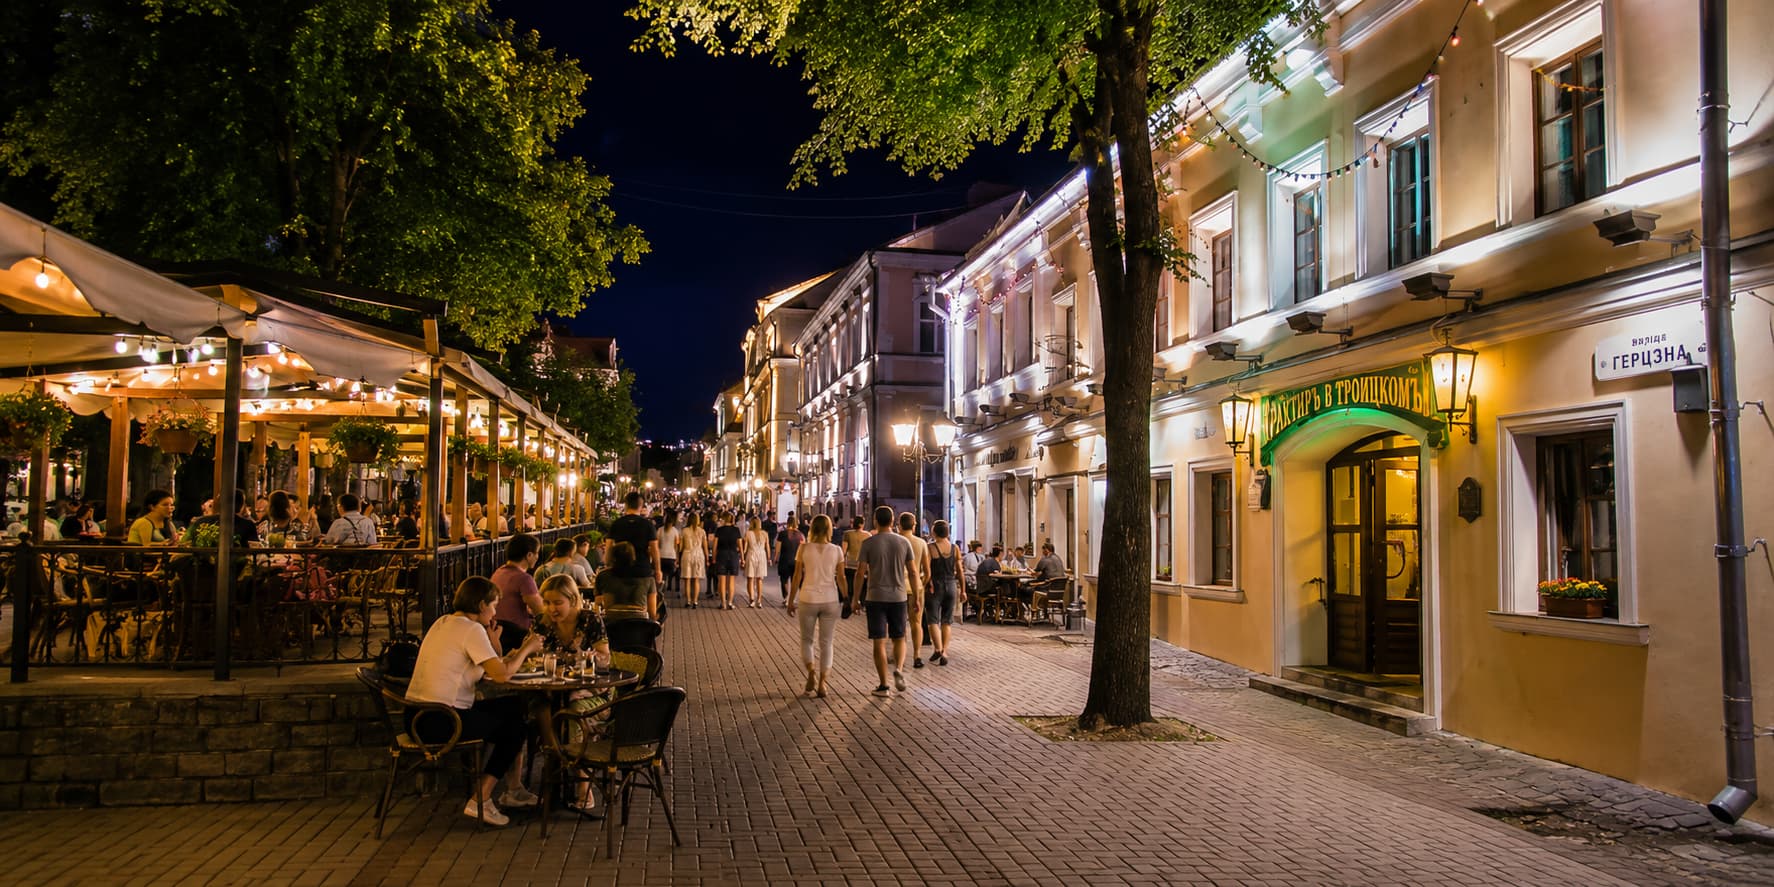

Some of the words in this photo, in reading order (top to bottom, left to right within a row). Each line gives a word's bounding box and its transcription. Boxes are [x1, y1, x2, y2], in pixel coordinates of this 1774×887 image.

[1613, 344, 1687, 370] ГЕРЦЭНА
[1325, 383, 1333, 408] В
[1335, 376, 1422, 414] ТРОИЦКОМЪ
